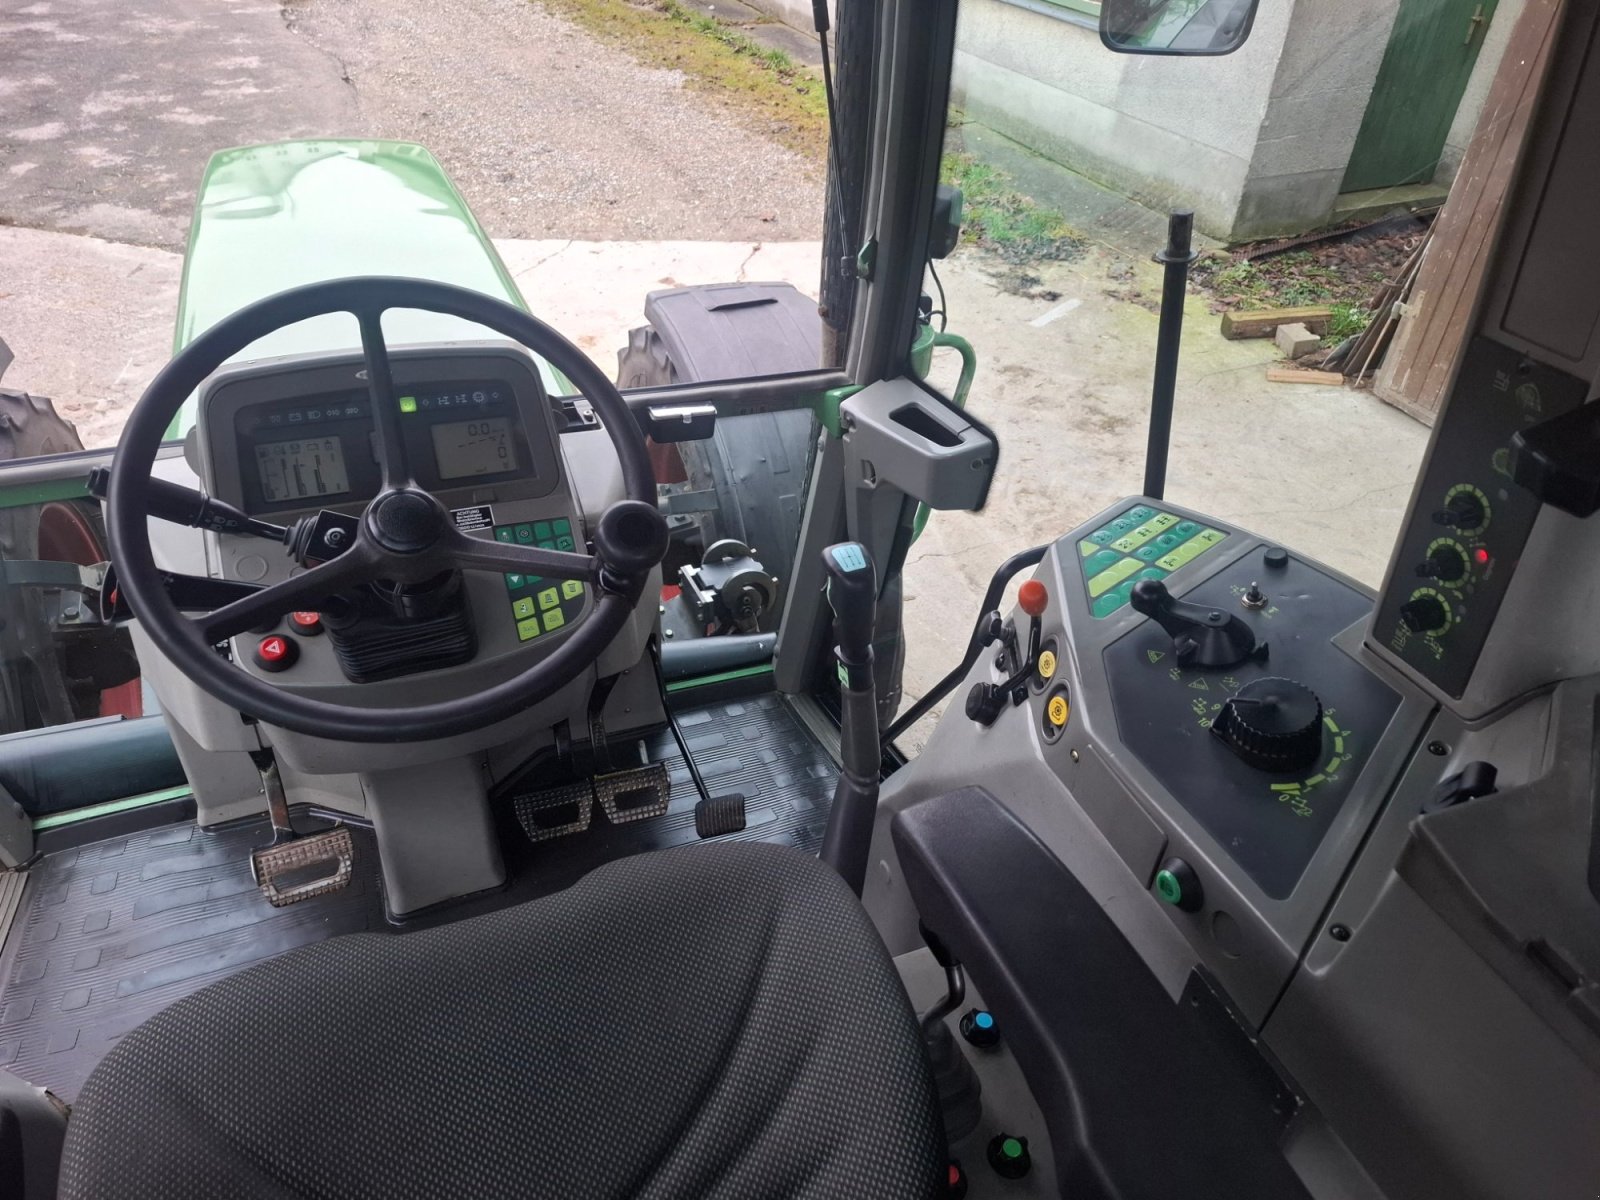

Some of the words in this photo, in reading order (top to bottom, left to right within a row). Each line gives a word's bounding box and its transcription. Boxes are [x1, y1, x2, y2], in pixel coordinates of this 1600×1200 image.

[1198, 717, 1211, 727] 10
[1341, 753, 1353, 761] 3
[1327, 774, 1339, 783] 2
